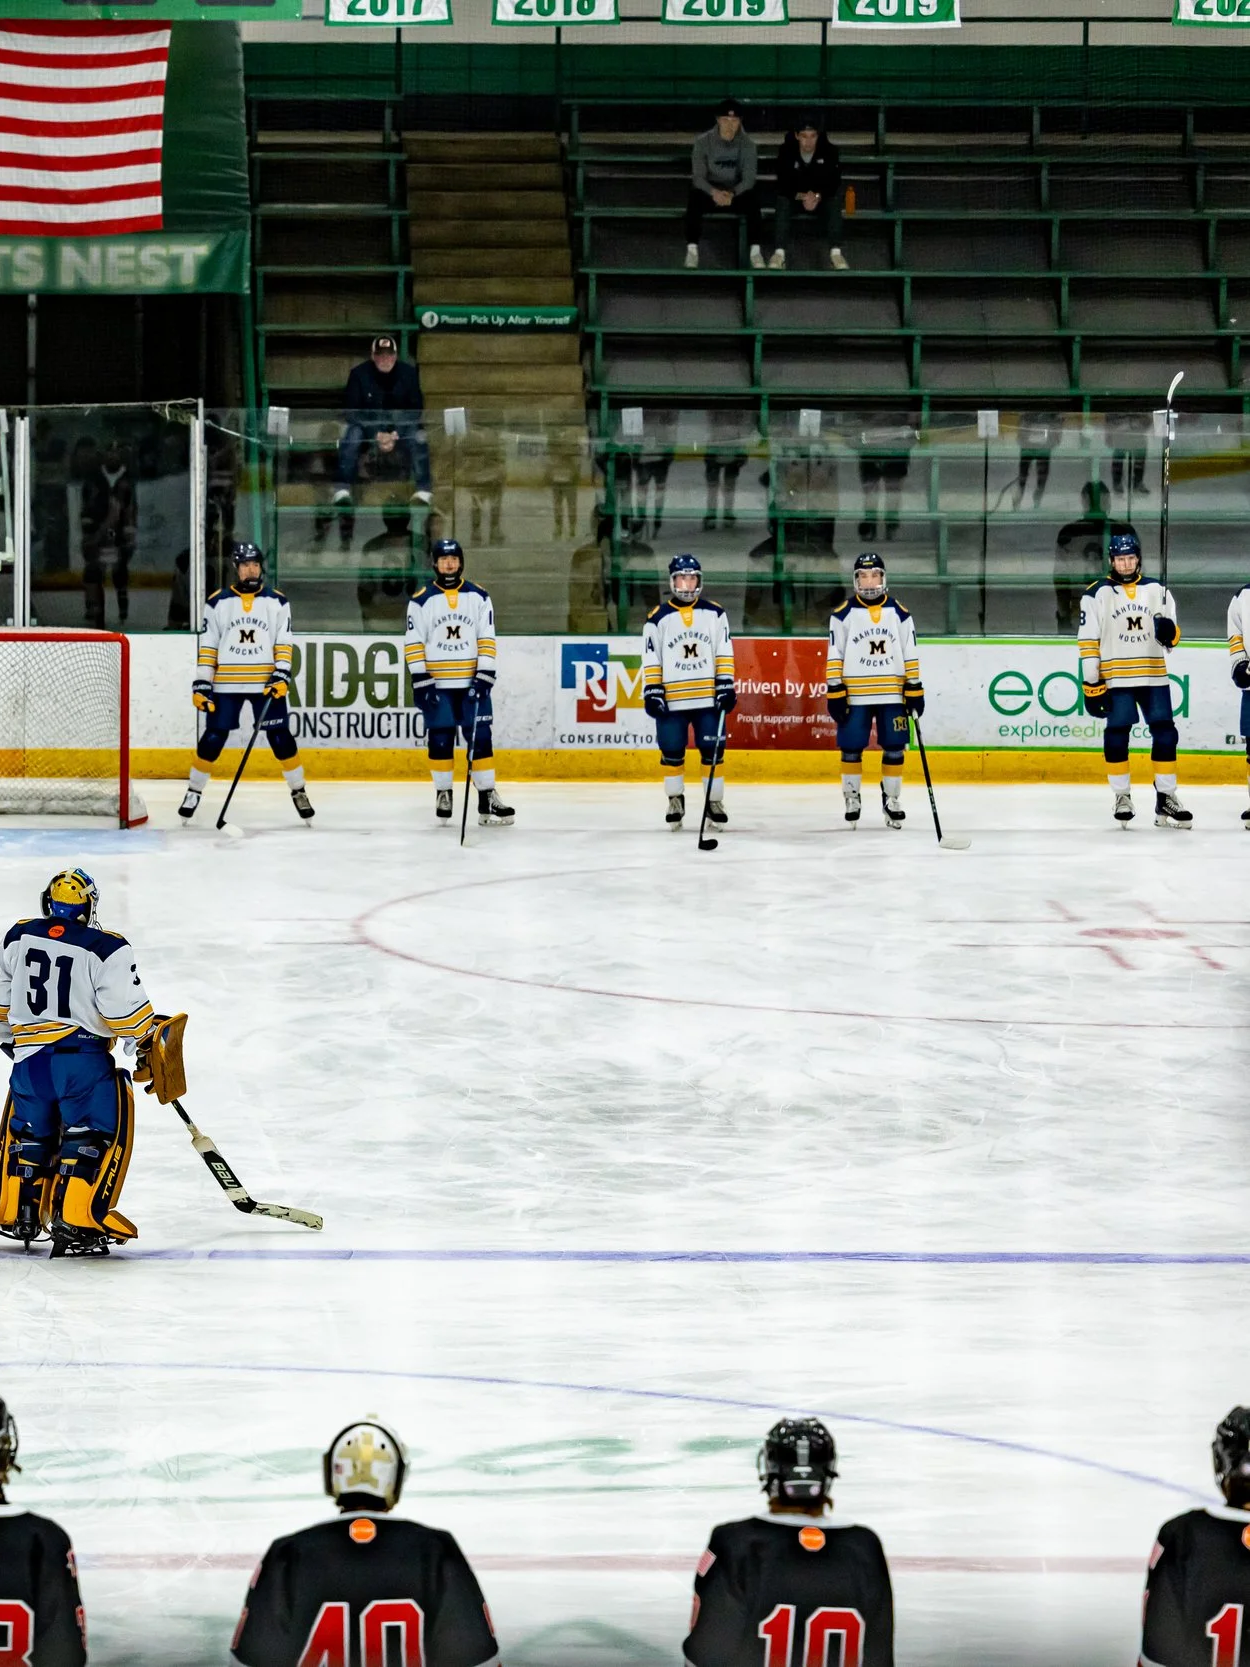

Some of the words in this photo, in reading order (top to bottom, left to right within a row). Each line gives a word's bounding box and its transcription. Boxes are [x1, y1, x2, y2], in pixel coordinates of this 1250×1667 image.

[855, 0, 938, 17] 2019
[60, 244, 208, 288] NEST
[470, 315, 488, 324] Pick
[491, 315, 505, 327] Up
[507, 315, 530, 324] After
[239, 629, 256, 644] M
[674, 658, 708, 671] HOCKEY
[733, 679, 780, 695] driven
[785, 679, 805, 698] by
[808, 682, 829, 698] yo
[289, 711, 428, 739] ONSTRUCTIO
[737, 713, 762, 723] Proud
[763, 714, 804, 724] supporter
[806, 713, 815, 723] of
[559, 734, 654, 744] CONSTRUCTIO
[25, 947, 75, 1019] 31
